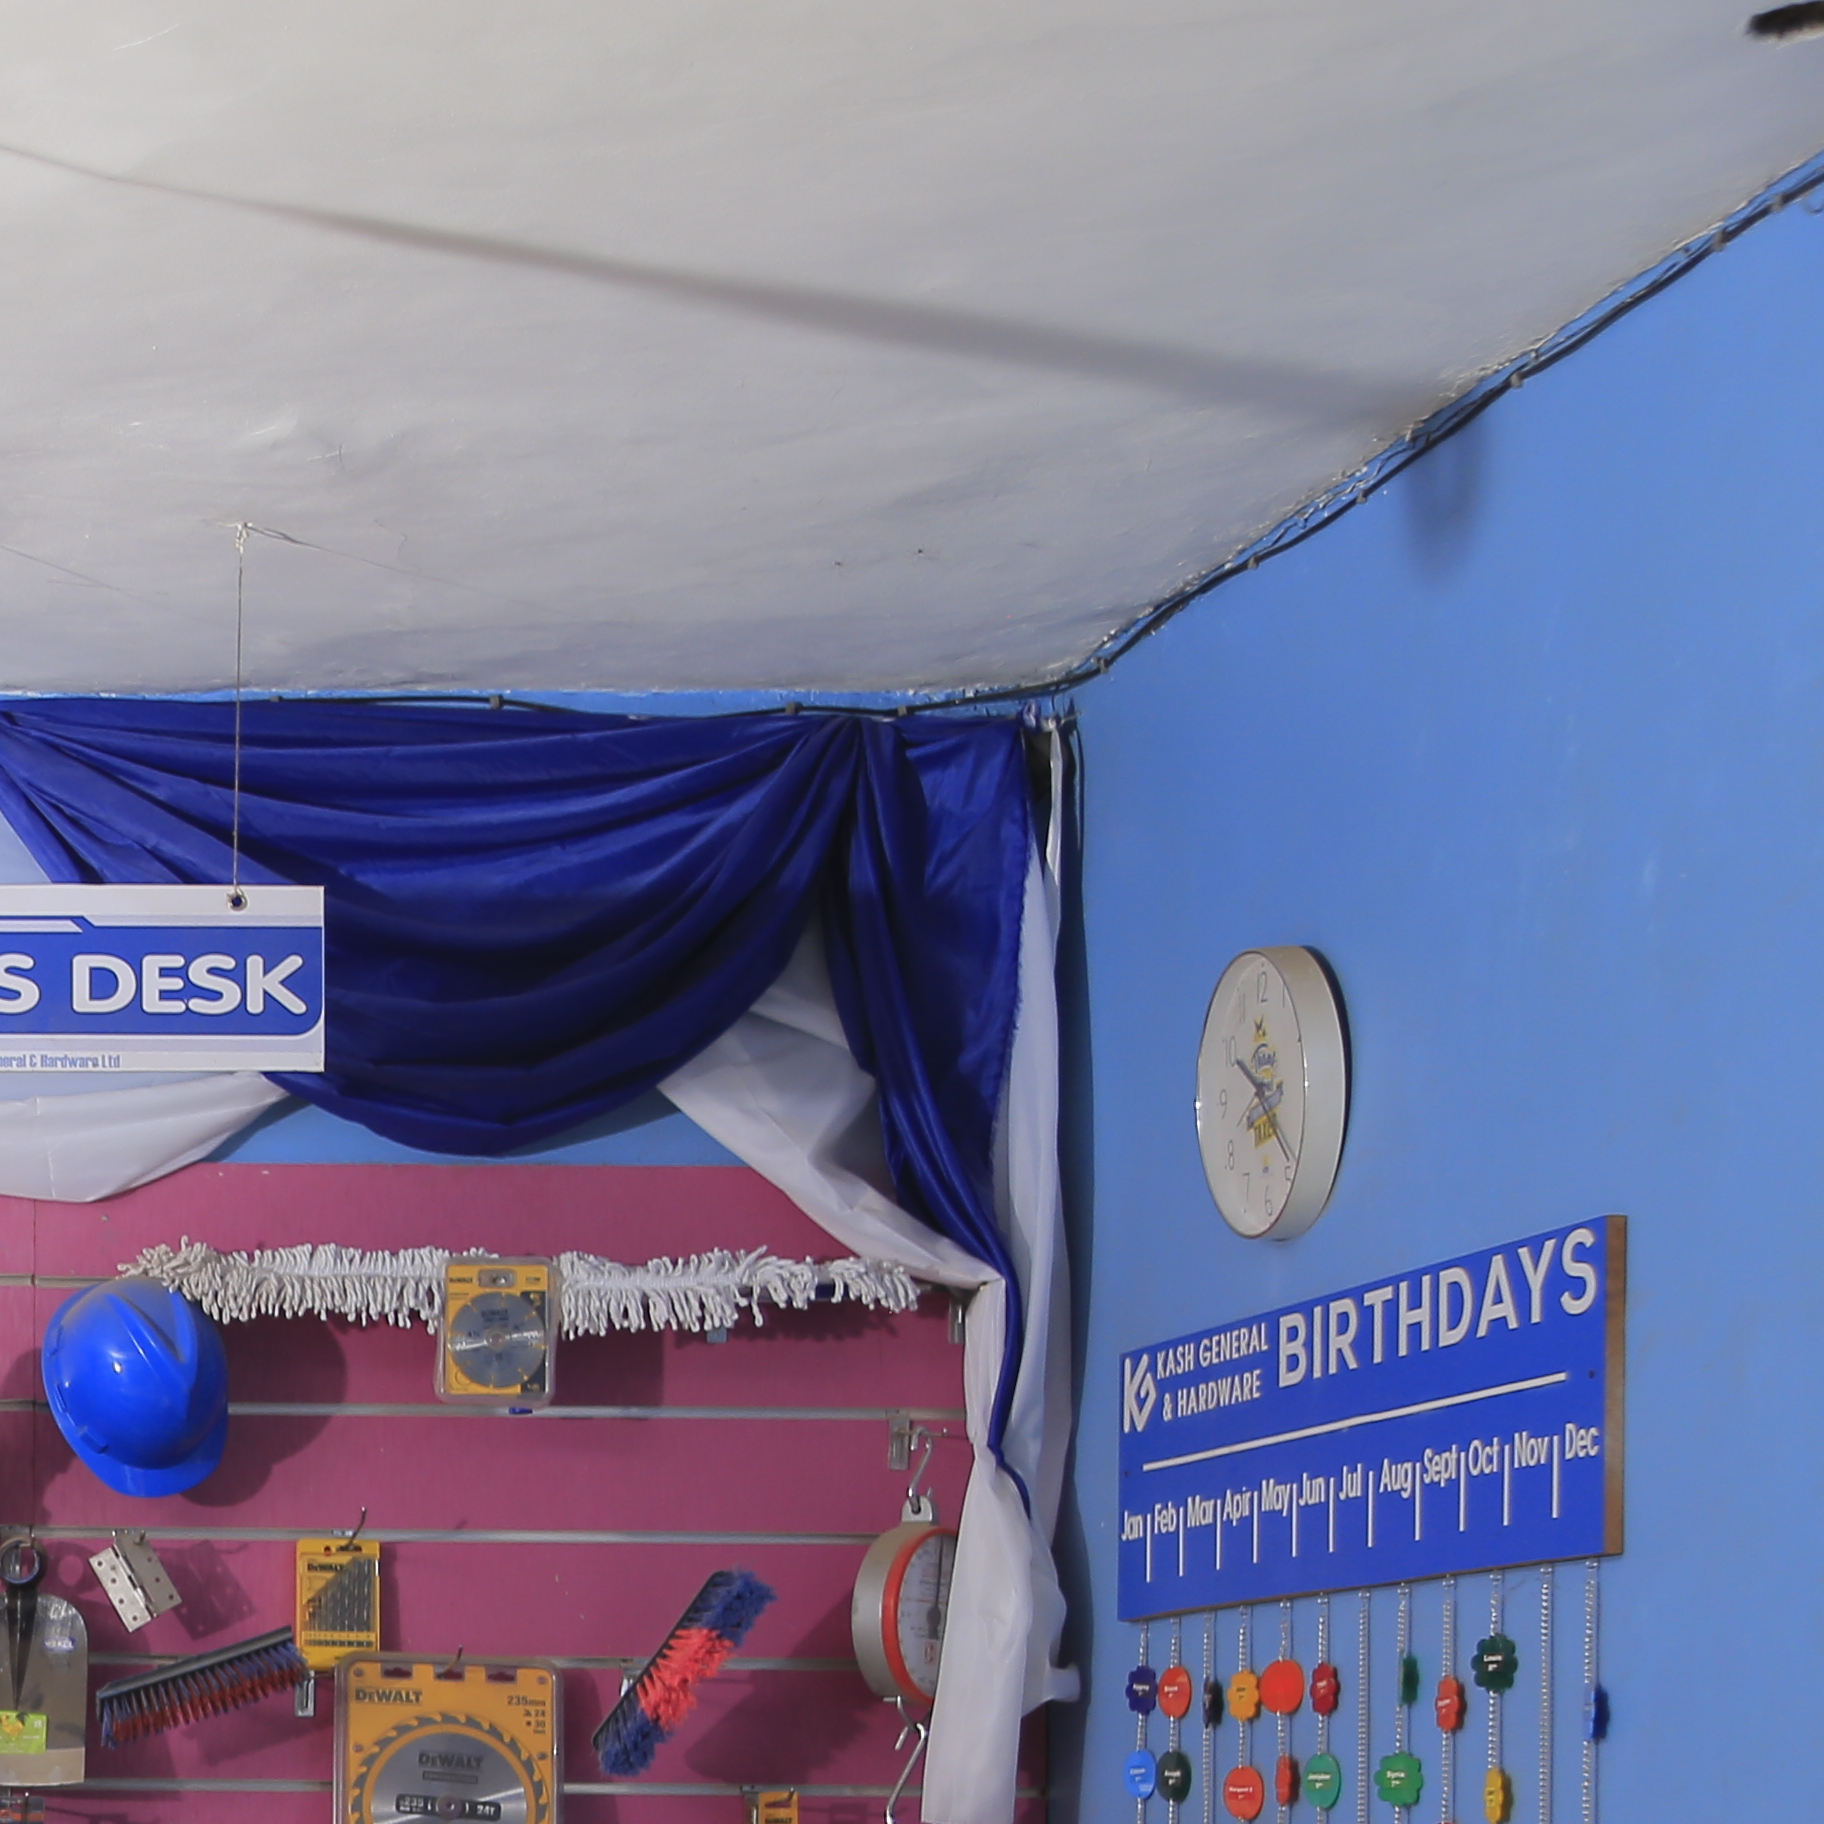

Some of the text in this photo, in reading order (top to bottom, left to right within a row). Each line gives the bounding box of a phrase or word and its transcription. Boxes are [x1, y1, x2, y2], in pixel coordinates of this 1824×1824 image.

[71, 952, 309, 1015] DESK
[1256, 970, 1268, 1003] 12
[29, 1054, 37, 1068] &
[40, 1054, 99, 1068] Hardware
[101, 1054, 120, 1068] Ltd
[1222, 1035, 1237, 1068] 10
[1219, 1089, 1227, 1119] 9
[1227, 1139, 1234, 1171] 8
[1243, 1172, 1250, 1202] 7
[1264, 1185, 1273, 1217] 6
[1278, 1227, 1598, 1388] BIRTHDAYS
[1156, 1322, 1269, 1380] KASH GENERAL
[1162, 1368, 1262, 1423] & HARDWARE
[1121, 1510, 1143, 1541] Jan
[1154, 1504, 1177, 1535] Feb
[1187, 1497, 1215, 1529] Mar
[1261, 1479, 1291, 1516] May
[1298, 1475, 1326, 1507] Jun
[1338, 1463, 1362, 1500] Jul
[1379, 1458, 1413, 1499] Aug
[1422, 1444, 1458, 1490] Sept
[1468, 1437, 1500, 1476] Oct
[1514, 1431, 1549, 1468] Nov
[1565, 1423, 1601, 1459] Dec
[507, 1695, 546, 1707] 235mm
